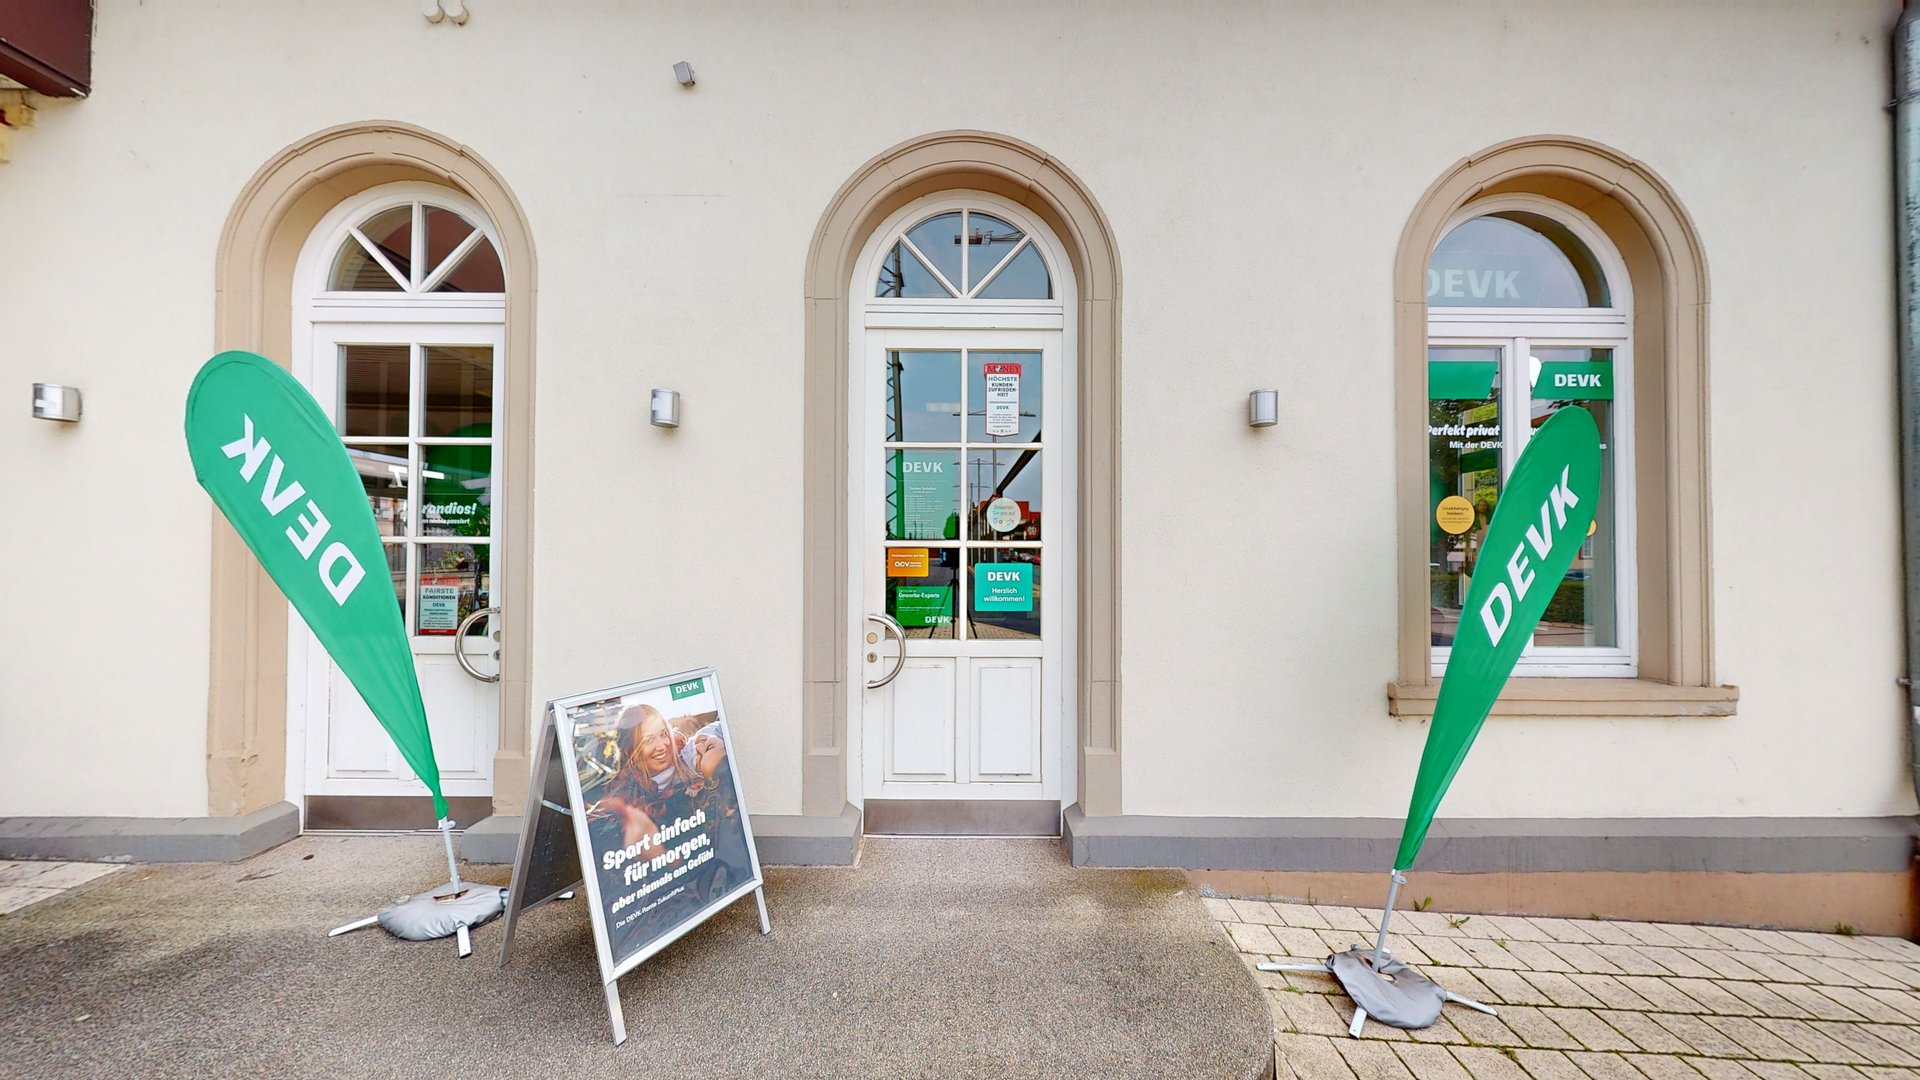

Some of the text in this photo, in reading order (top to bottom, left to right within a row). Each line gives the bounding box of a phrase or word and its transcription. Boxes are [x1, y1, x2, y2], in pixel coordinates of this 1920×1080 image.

[1554, 373, 1601, 387] DEVK
[1465, 424, 1500, 438] privat
[1449, 441, 1503, 449] Mit der DEVK
[903, 461, 943, 473] DEVK
[422, 501, 477, 515] randios!
[993, 517, 1014, 526] Gogle
[1480, 463, 1580, 648] DEVK
[987, 571, 1020, 581] DEVK
[924, 616, 950, 624] DEVK
[675, 682, 699, 694] DEVK
[603, 809, 706, 870] Spart einfach
[624, 833, 711, 886] für morgen,
[612, 848, 714, 914] aber niemals am Gefühl
[616, 919, 626, 929] Die
